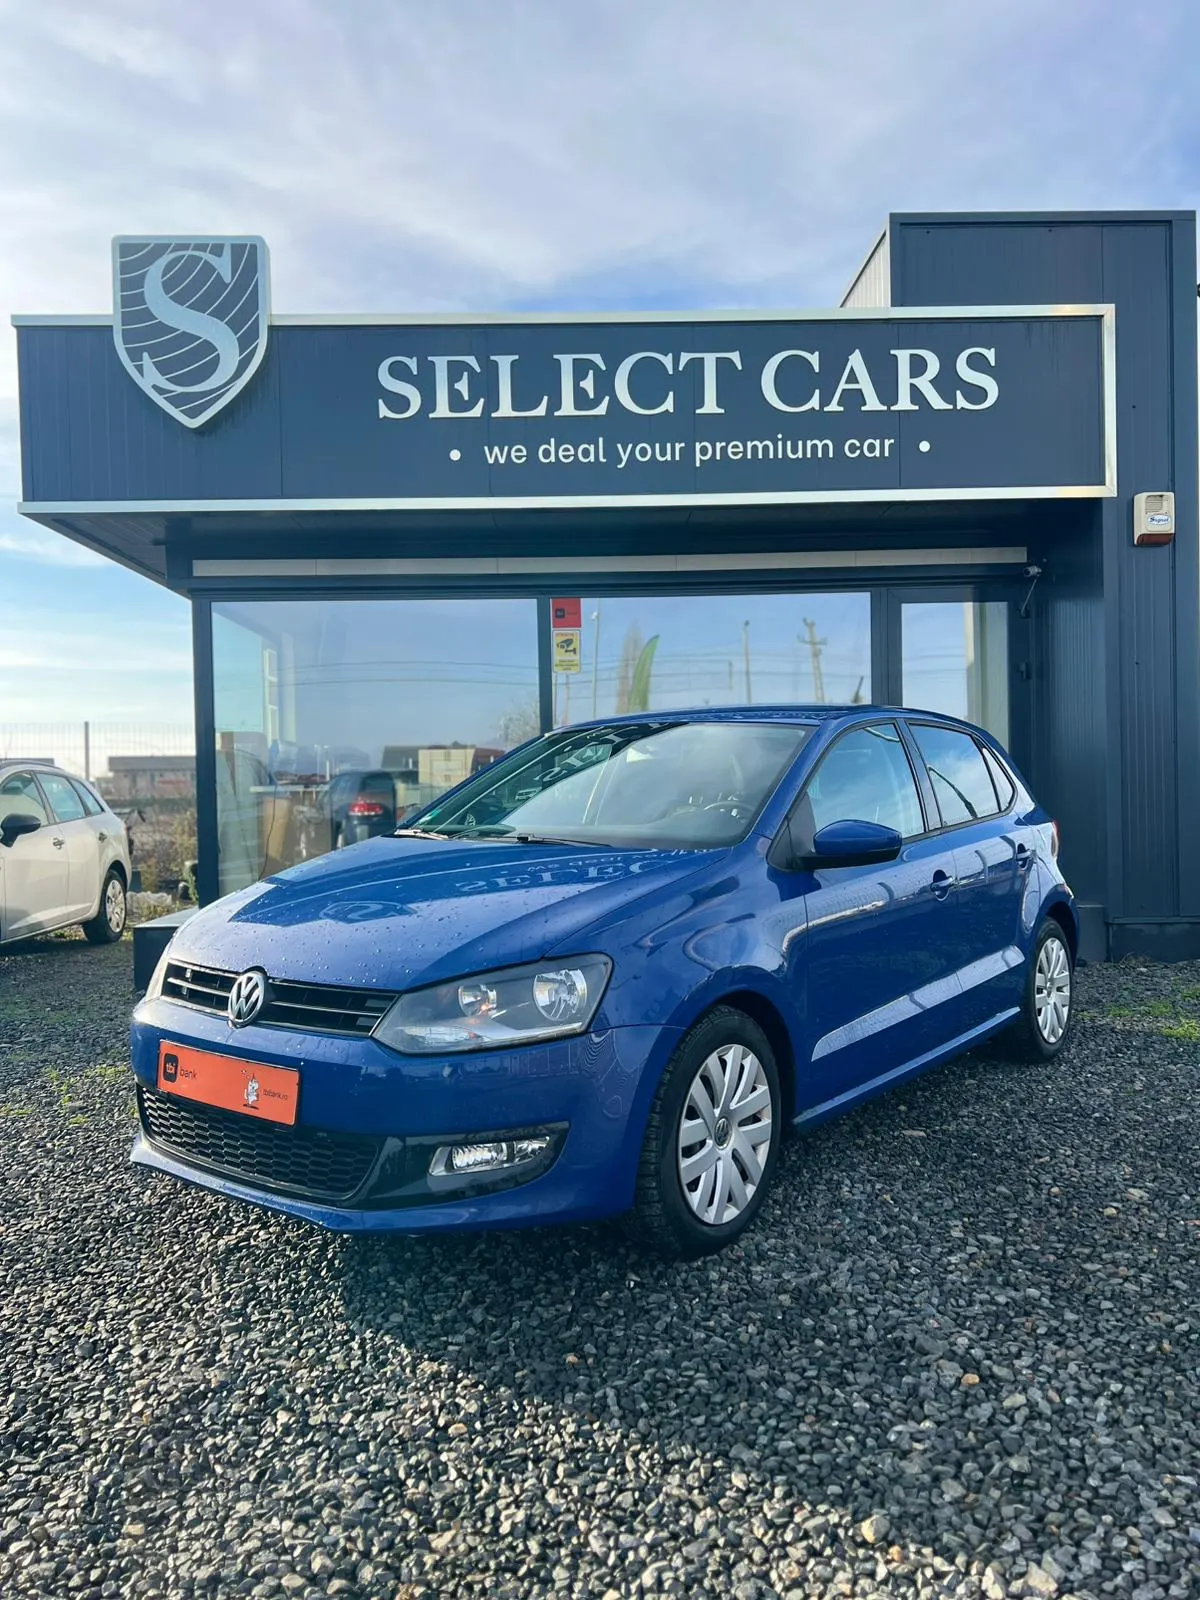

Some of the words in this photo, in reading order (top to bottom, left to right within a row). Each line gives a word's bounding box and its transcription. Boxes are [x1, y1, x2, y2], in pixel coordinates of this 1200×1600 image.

[377, 350, 743, 420] SELECT
[760, 347, 999, 412] CARS
[484, 444, 527, 465] we
[537, 437, 606, 464] deal
[616, 440, 685, 469] your
[694, 433, 834, 468] premium
[843, 437, 895, 459] car
[179, 1065, 198, 1080] bank
